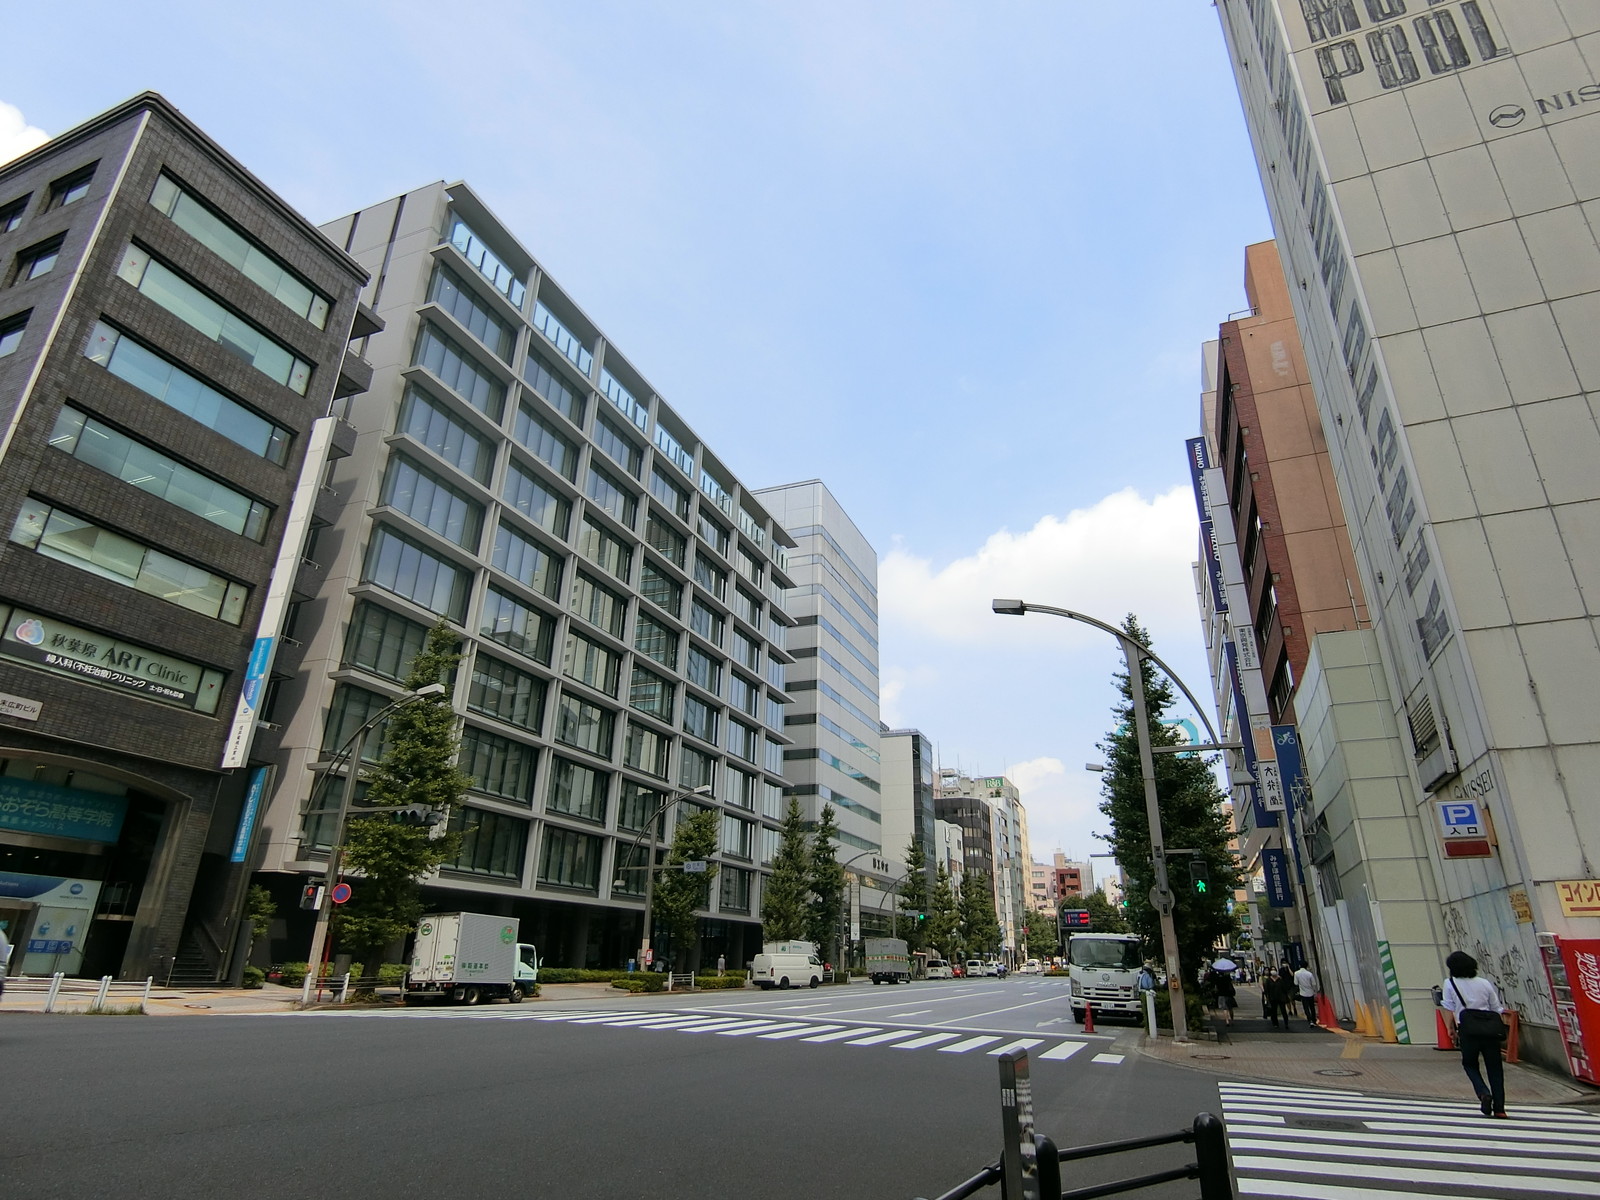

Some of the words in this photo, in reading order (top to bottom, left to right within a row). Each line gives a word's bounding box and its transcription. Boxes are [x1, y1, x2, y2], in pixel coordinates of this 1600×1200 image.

[1315, 0, 1512, 106] POOL
[1194, 442, 1204, 469] MIZUHO
[51, 633, 99, 658] 秋葉原
[101, 647, 147, 672] ART
[147, 661, 189, 686] Clinic
[1463, 769, 1494, 799] NISSEI
[1448, 806, 1471, 824] P
[1450, 827, 1478, 835] 入口
